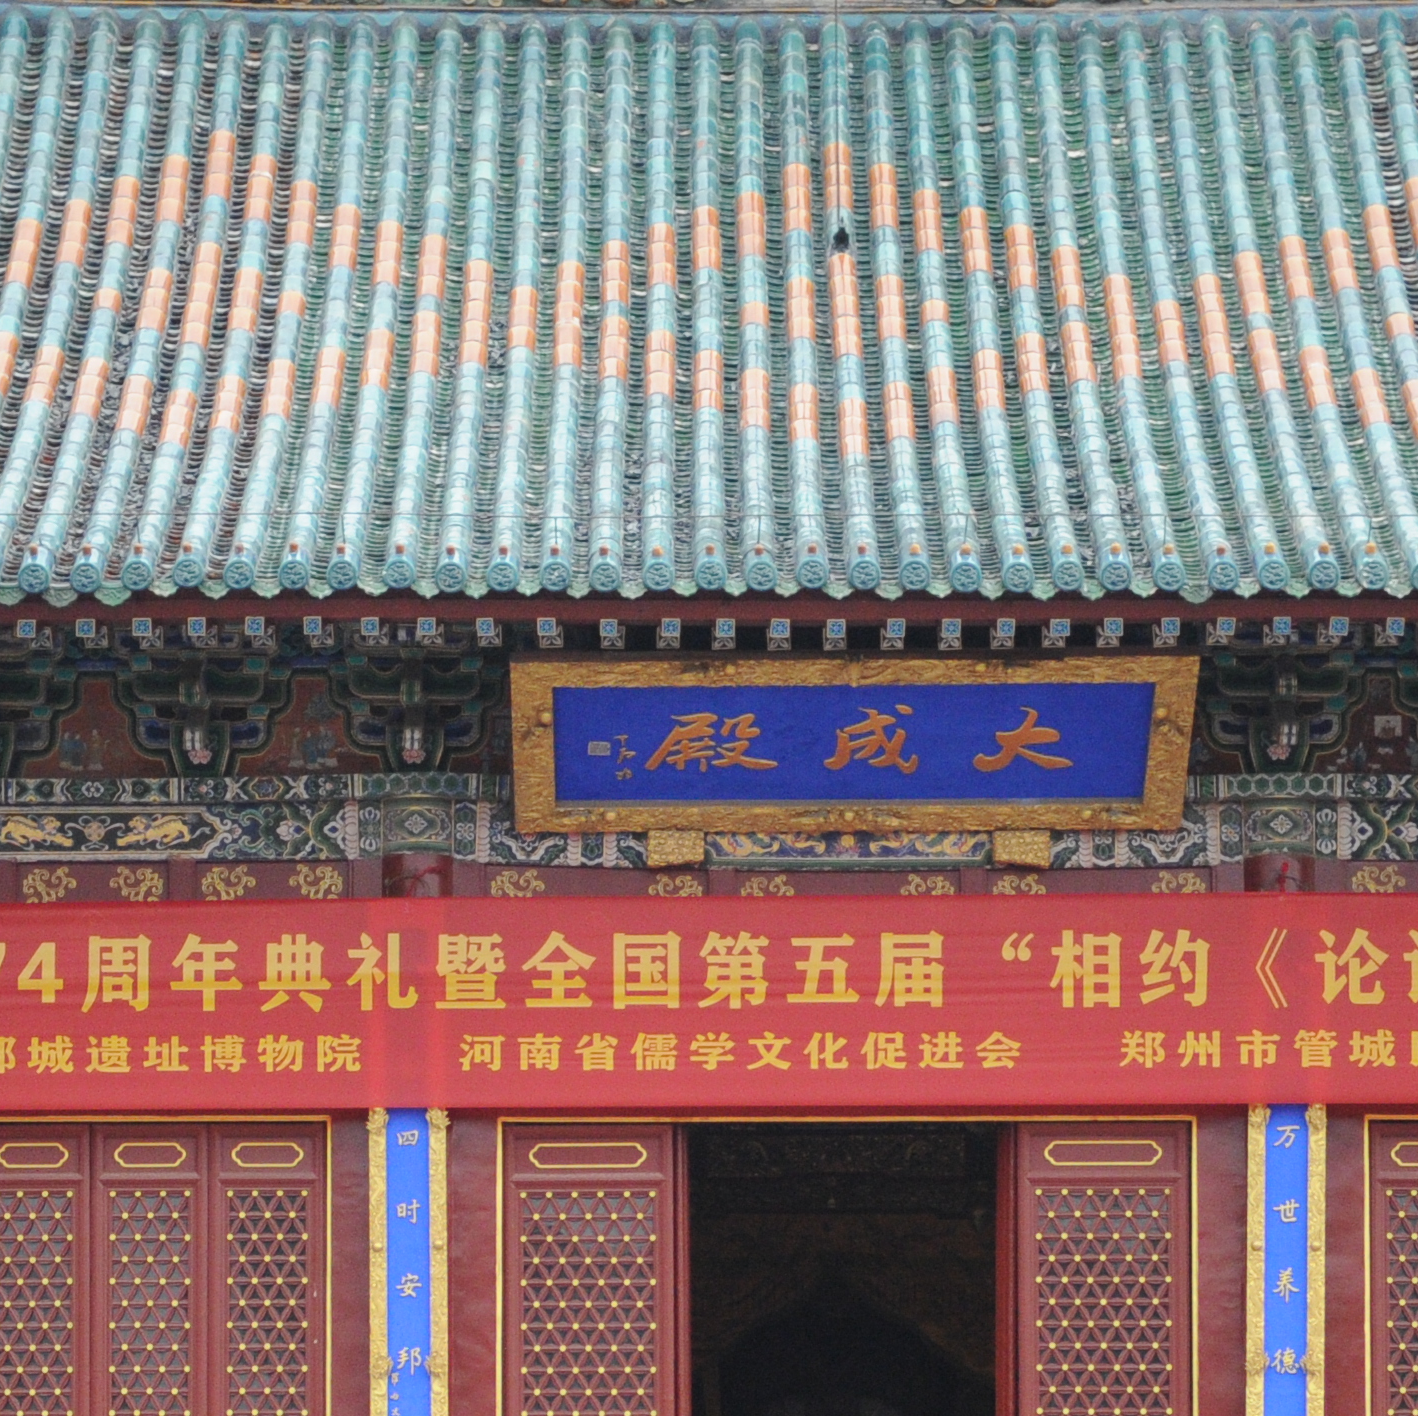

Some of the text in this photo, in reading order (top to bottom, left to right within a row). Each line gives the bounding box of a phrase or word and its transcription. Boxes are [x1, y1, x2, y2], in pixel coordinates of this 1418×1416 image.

[647, 704, 1072, 774] 大成殿
[459, 1030, 1022, 1072] 河南省儒学文化促进会
